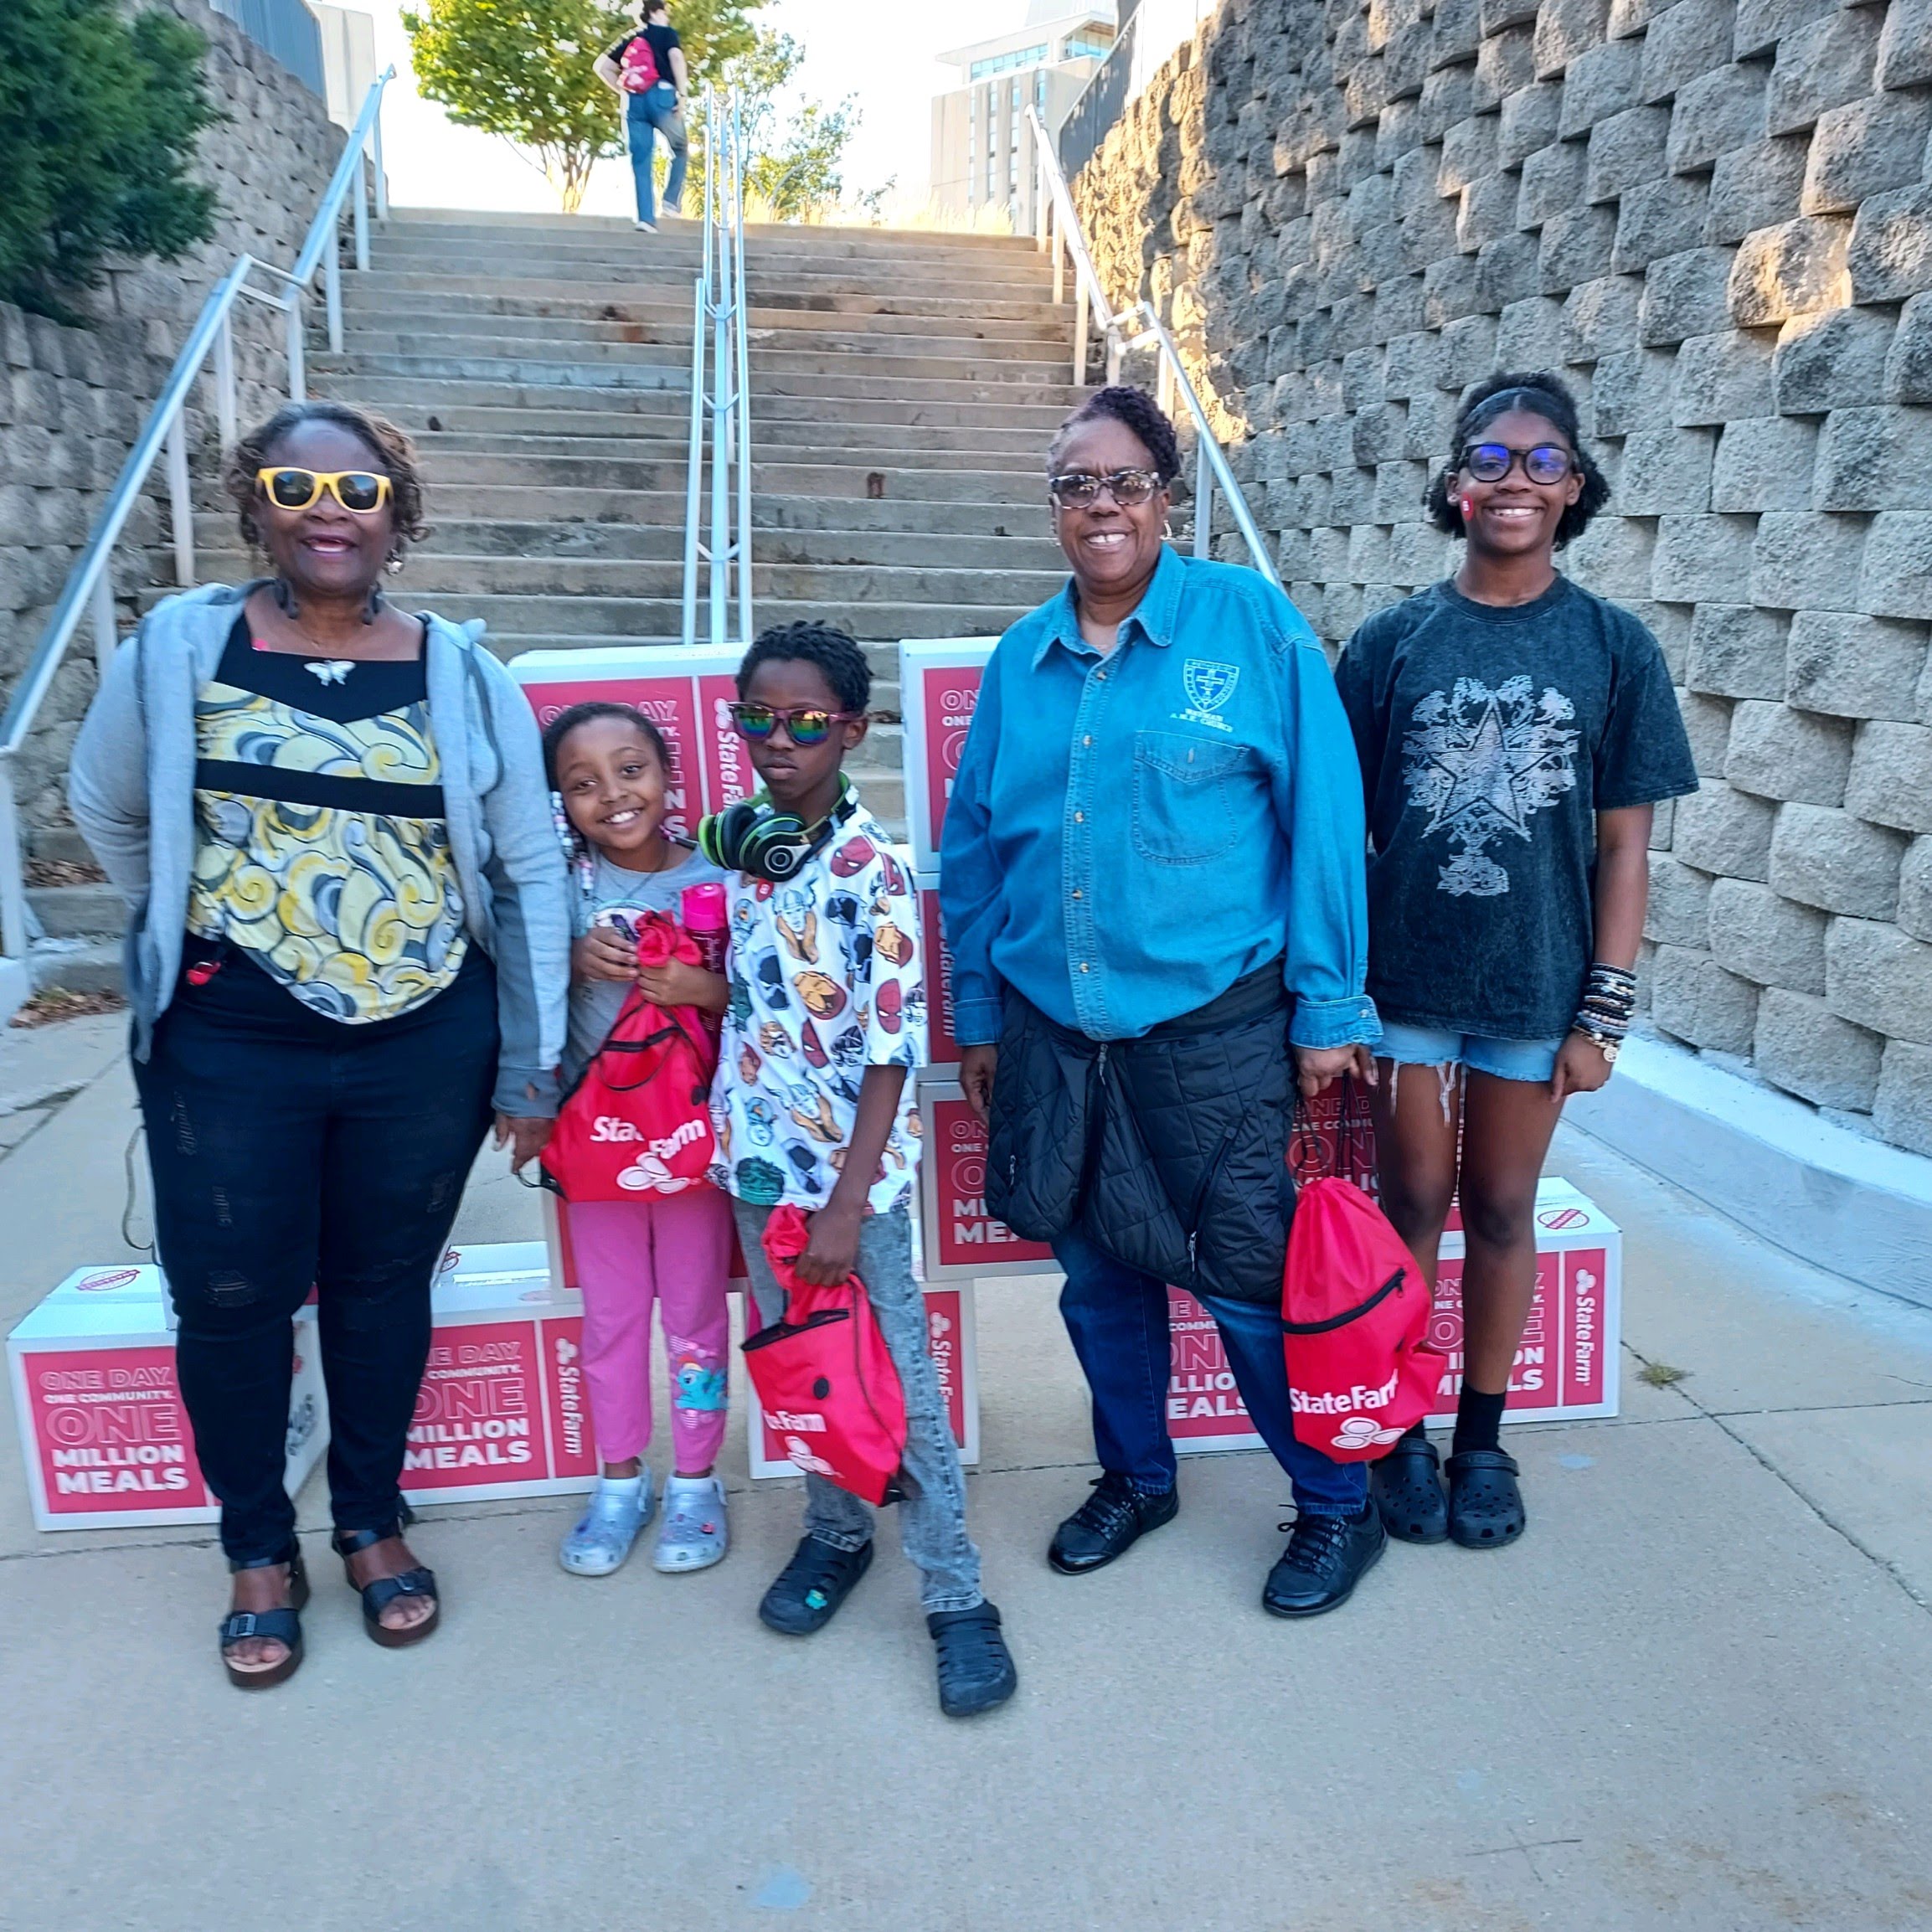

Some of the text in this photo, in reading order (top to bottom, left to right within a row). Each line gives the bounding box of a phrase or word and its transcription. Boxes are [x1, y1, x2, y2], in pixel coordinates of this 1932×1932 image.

[940, 689, 981, 711] ON
[716, 730, 743, 808] StateFa
[949, 1120, 990, 1140] ON
[951, 1142, 983, 1153] ONE
[1574, 1296, 1595, 1383] StateFarm
[40, 1371, 105, 1390] ONE
[43, 1394, 78, 1404] ONE
[558, 1366, 585, 1455] StateFarm
[45, 1404, 183, 1445] ONE
[406, 1418, 530, 1444] MILLION
[51, 1444, 187, 1468] MILLION
[403, 1440, 533, 1471] MEALS
[54, 1467, 189, 1495] MEALS
